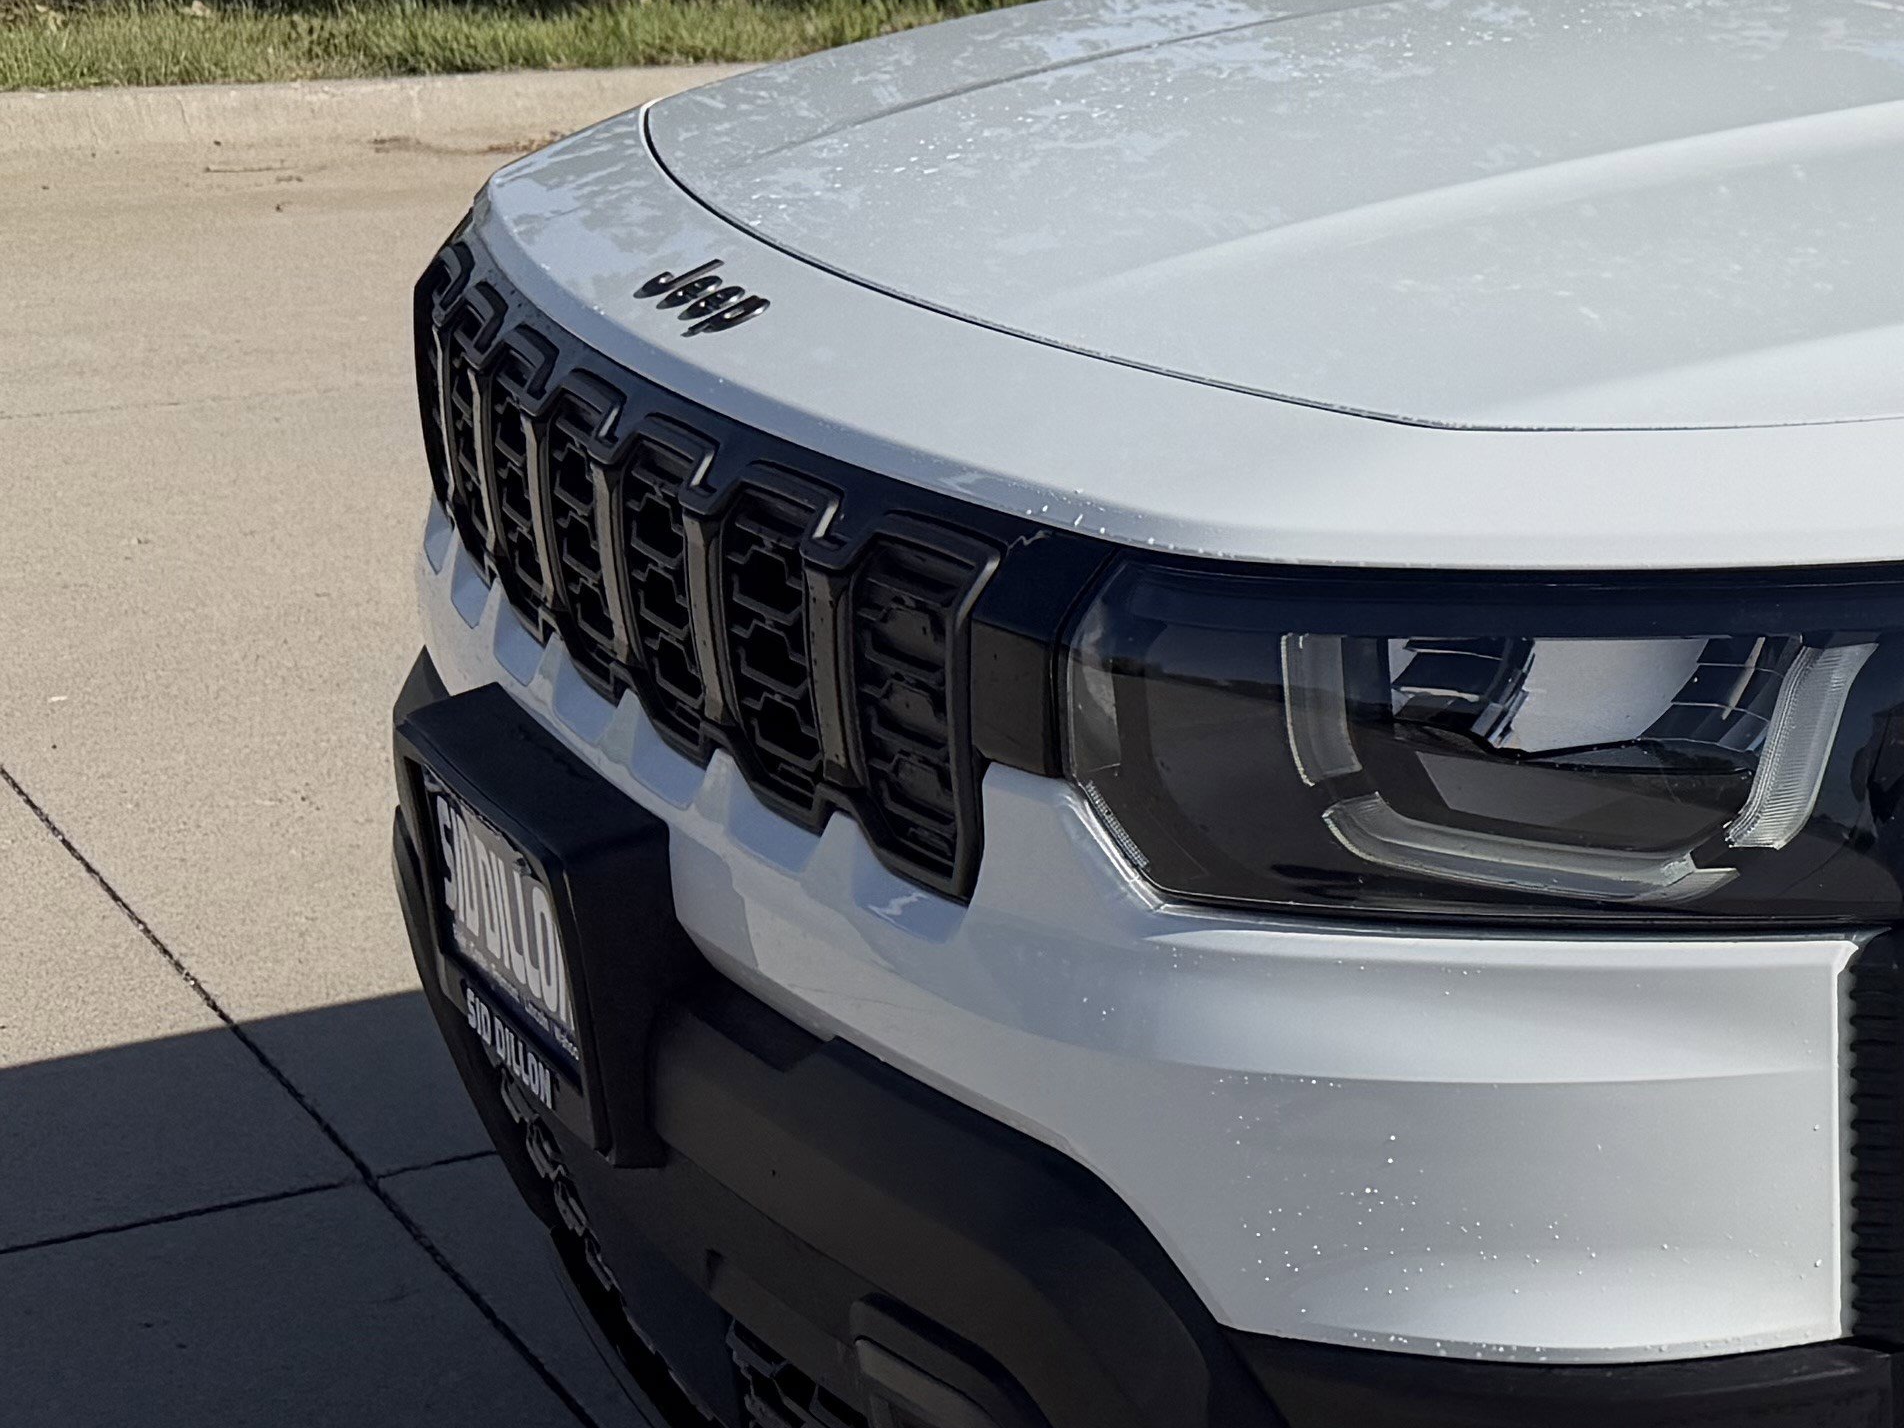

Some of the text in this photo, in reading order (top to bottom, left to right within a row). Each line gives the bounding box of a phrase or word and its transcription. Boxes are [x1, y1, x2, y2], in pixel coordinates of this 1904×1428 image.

[633, 258, 771, 337] Jeep
[436, 794, 480, 937] SID
[466, 987, 492, 1046] SID
[493, 1015, 552, 1110] DILLON
